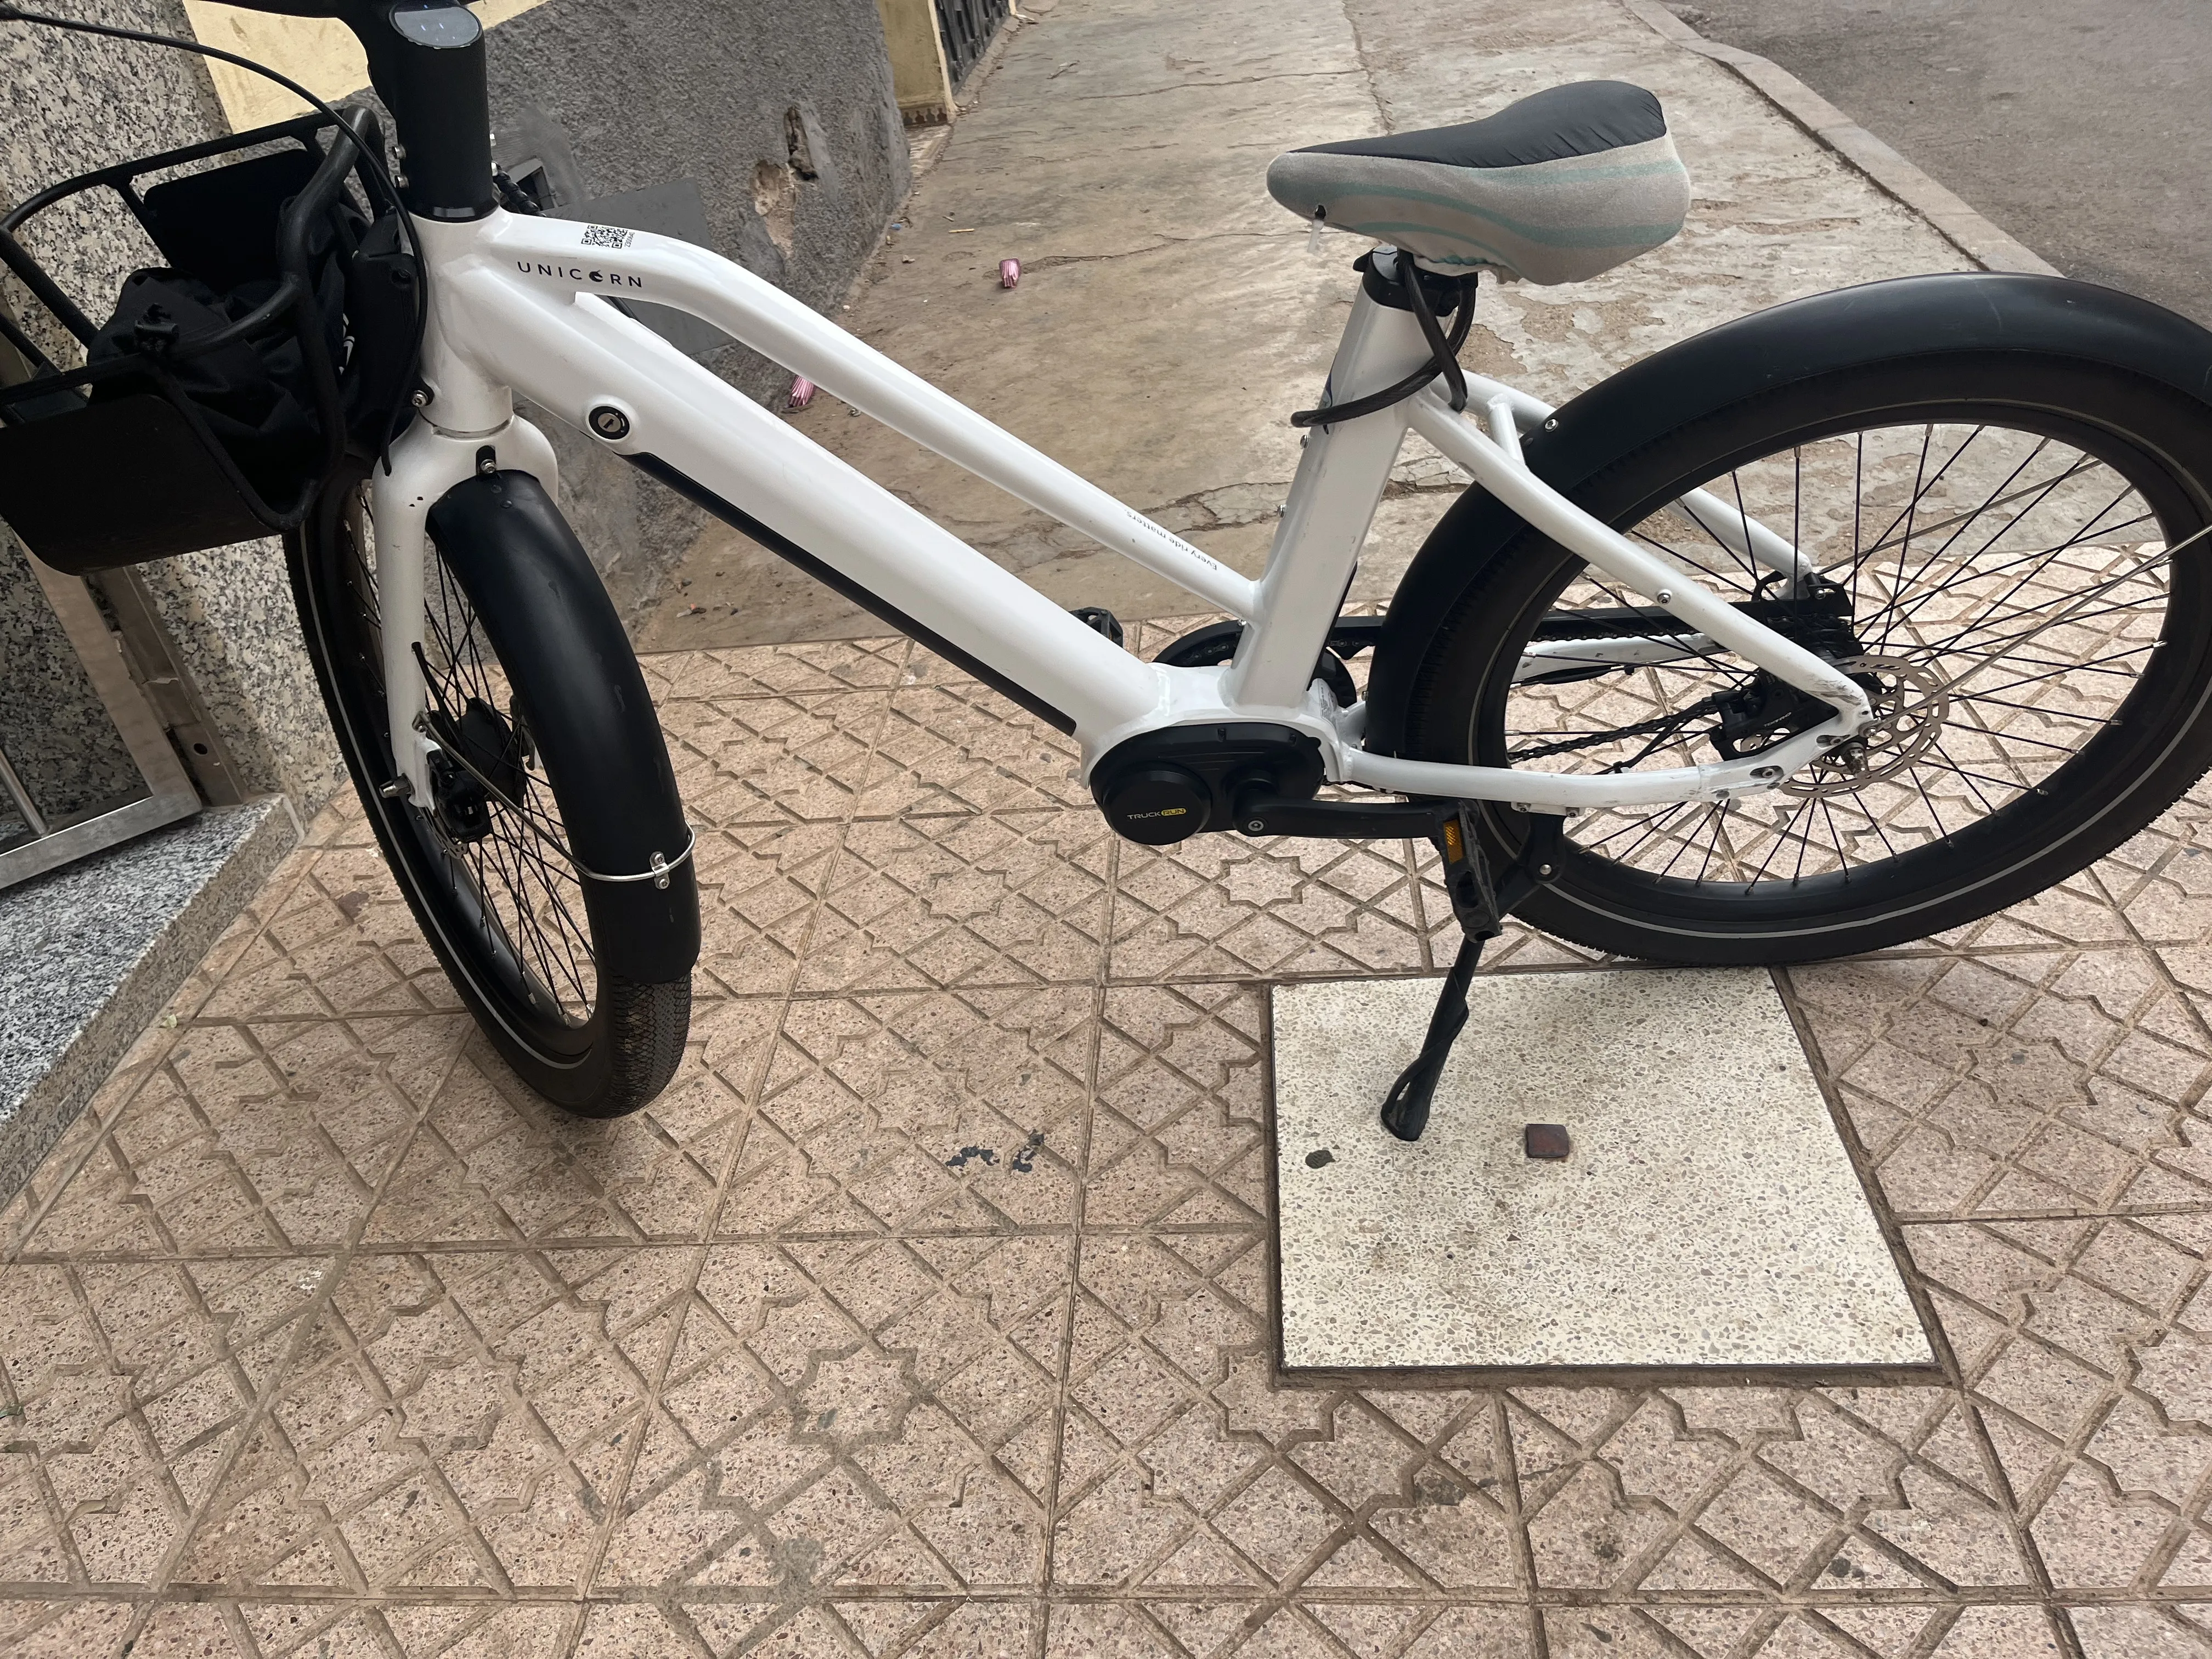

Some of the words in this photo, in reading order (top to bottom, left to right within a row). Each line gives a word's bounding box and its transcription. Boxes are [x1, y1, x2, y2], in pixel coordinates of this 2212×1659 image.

[517, 261, 642, 287] UNICORN
[1169, 537, 1188, 551] ride
[1191, 550, 1217, 571] Every
